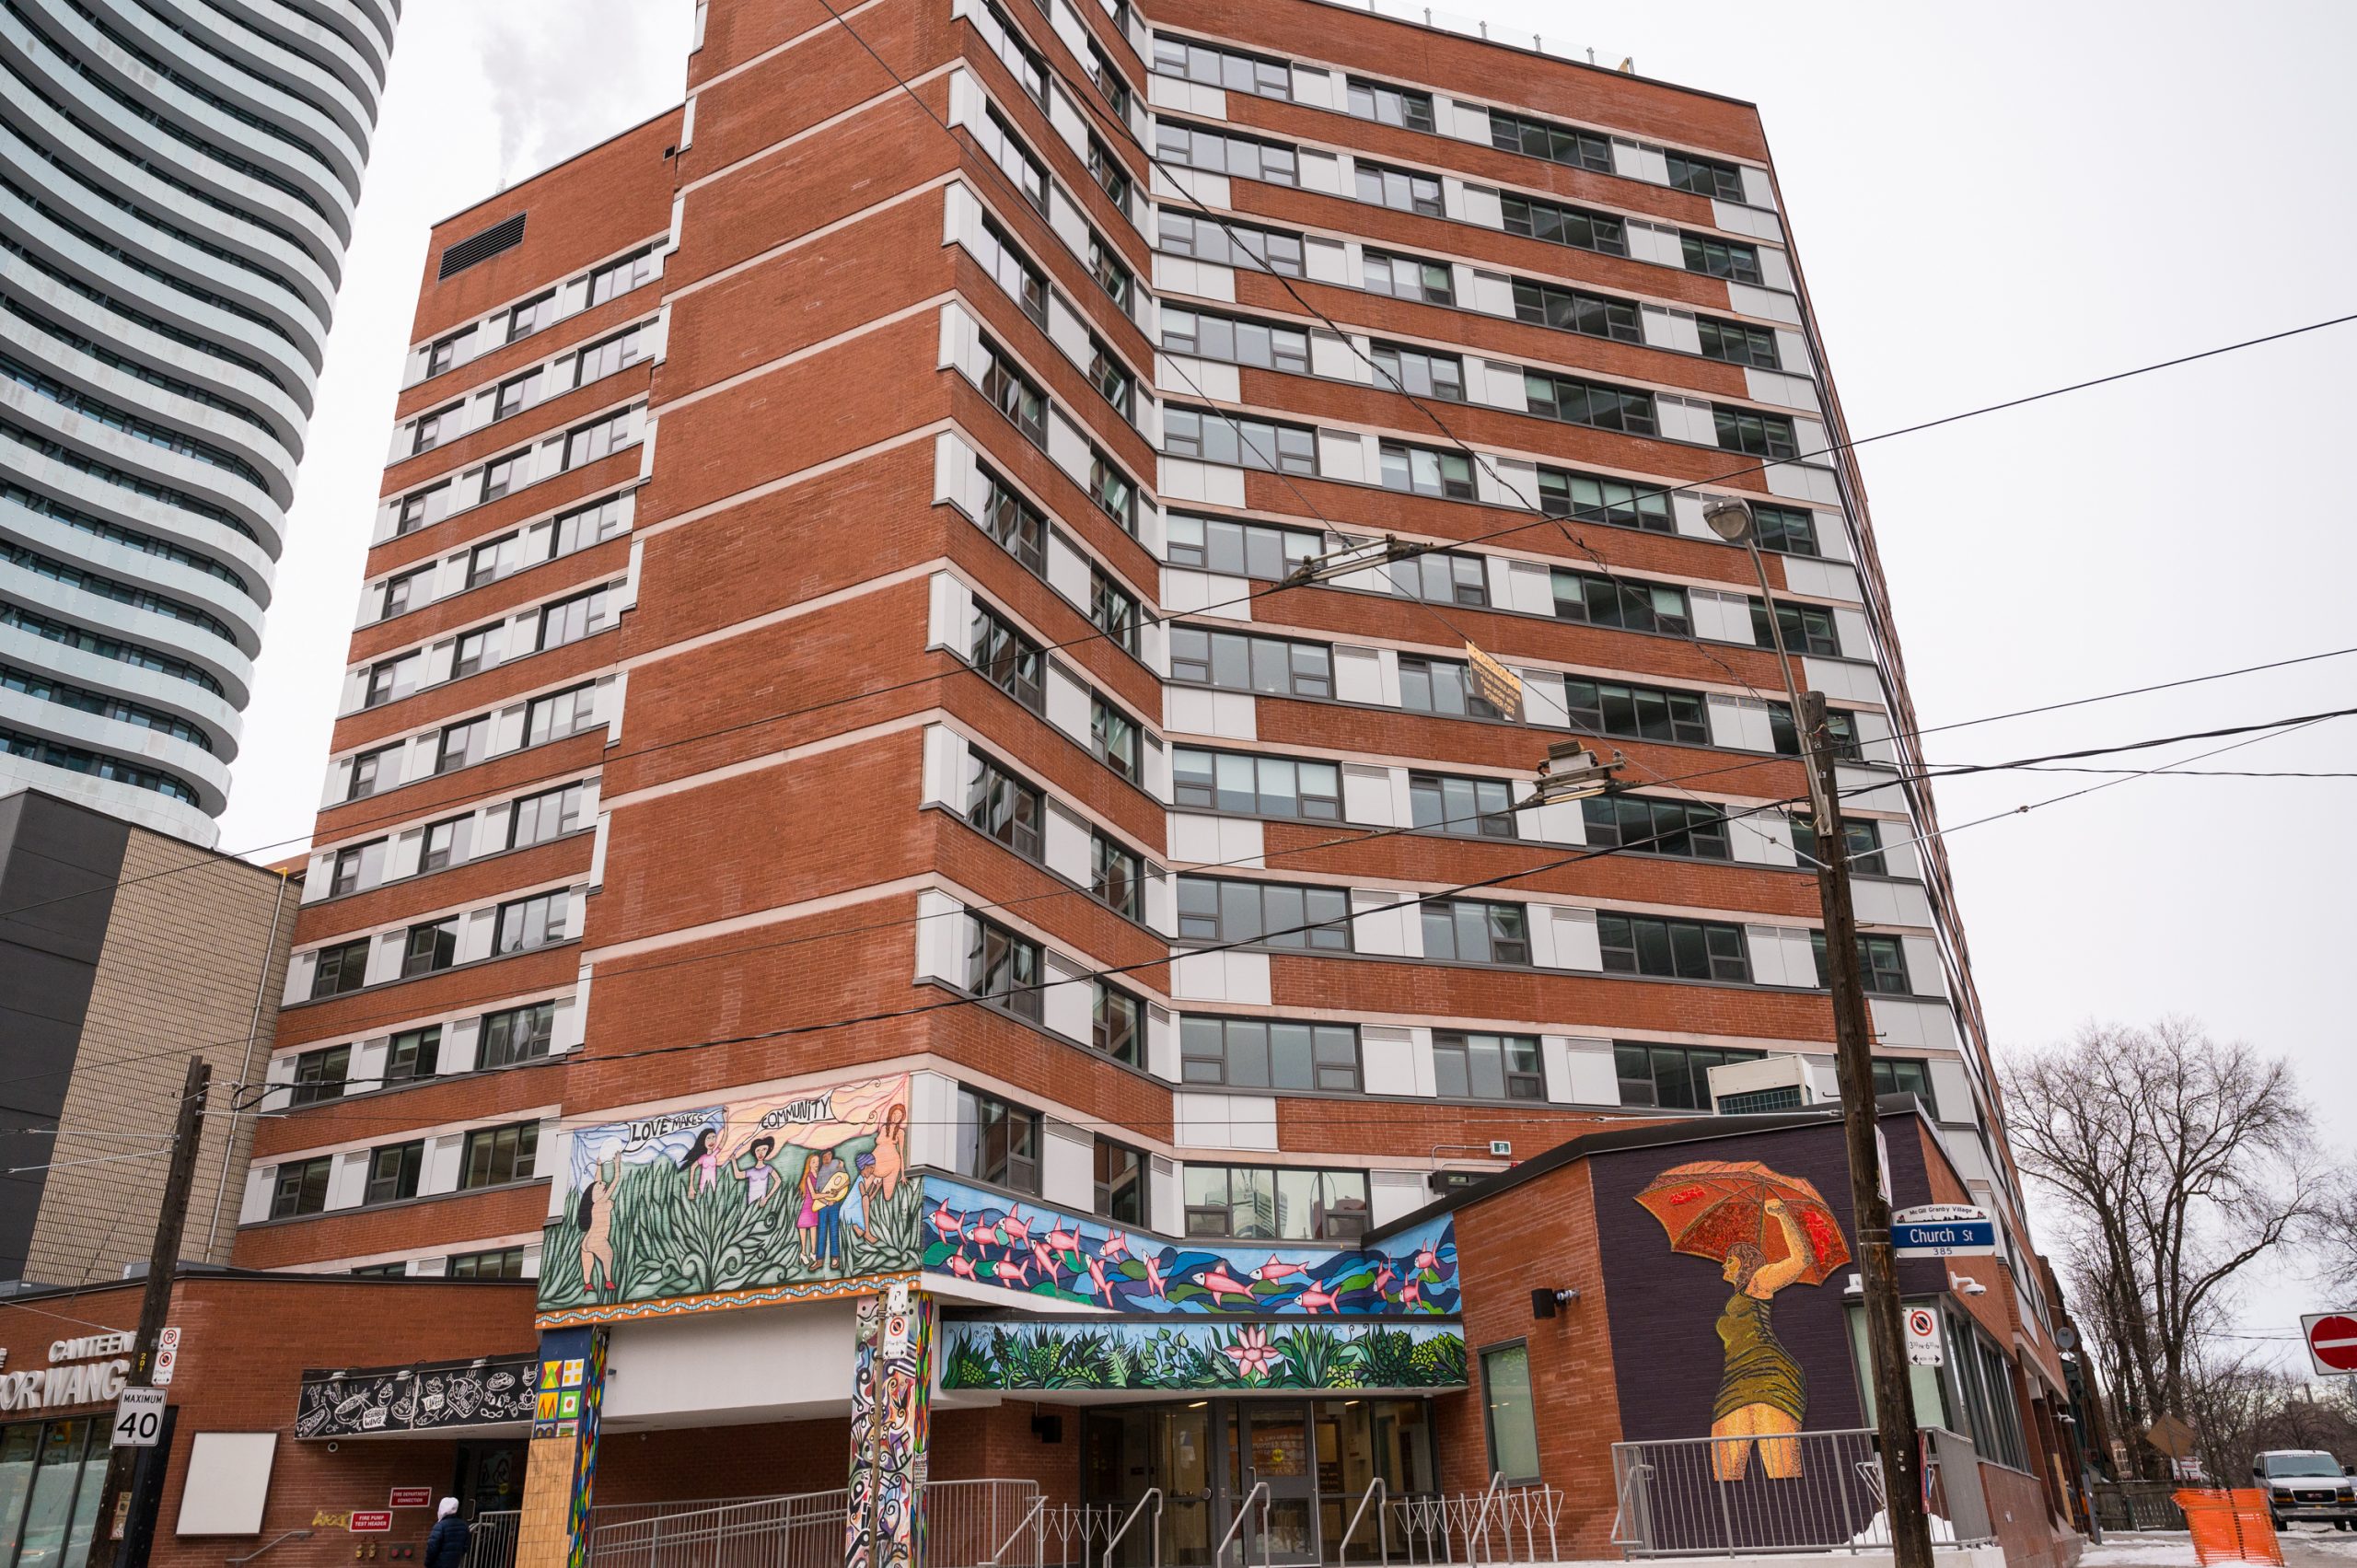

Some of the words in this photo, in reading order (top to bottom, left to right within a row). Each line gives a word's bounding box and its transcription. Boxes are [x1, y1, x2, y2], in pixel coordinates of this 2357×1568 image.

[1480, 654, 1508, 681] CAUTION
[1483, 687, 1504, 709] POWER
[1504, 702, 1515, 715] OFF
[631, 1118, 668, 1142] LOVE
[671, 1112, 702, 1131] MAKES
[761, 1097, 828, 1128] COMMUNITY
[1952, 1206, 1972, 1214] Village
[1910, 1227, 1956, 1244] Church
[1962, 1229, 1974, 1242] St
[1933, 1247, 1953, 1256] 385
[49, 1330, 137, 1363] CANTEEN
[43, 1359, 131, 1408] WANG
[123, 1393, 163, 1404] MAXIMUM
[117, 1412, 158, 1438] 40
